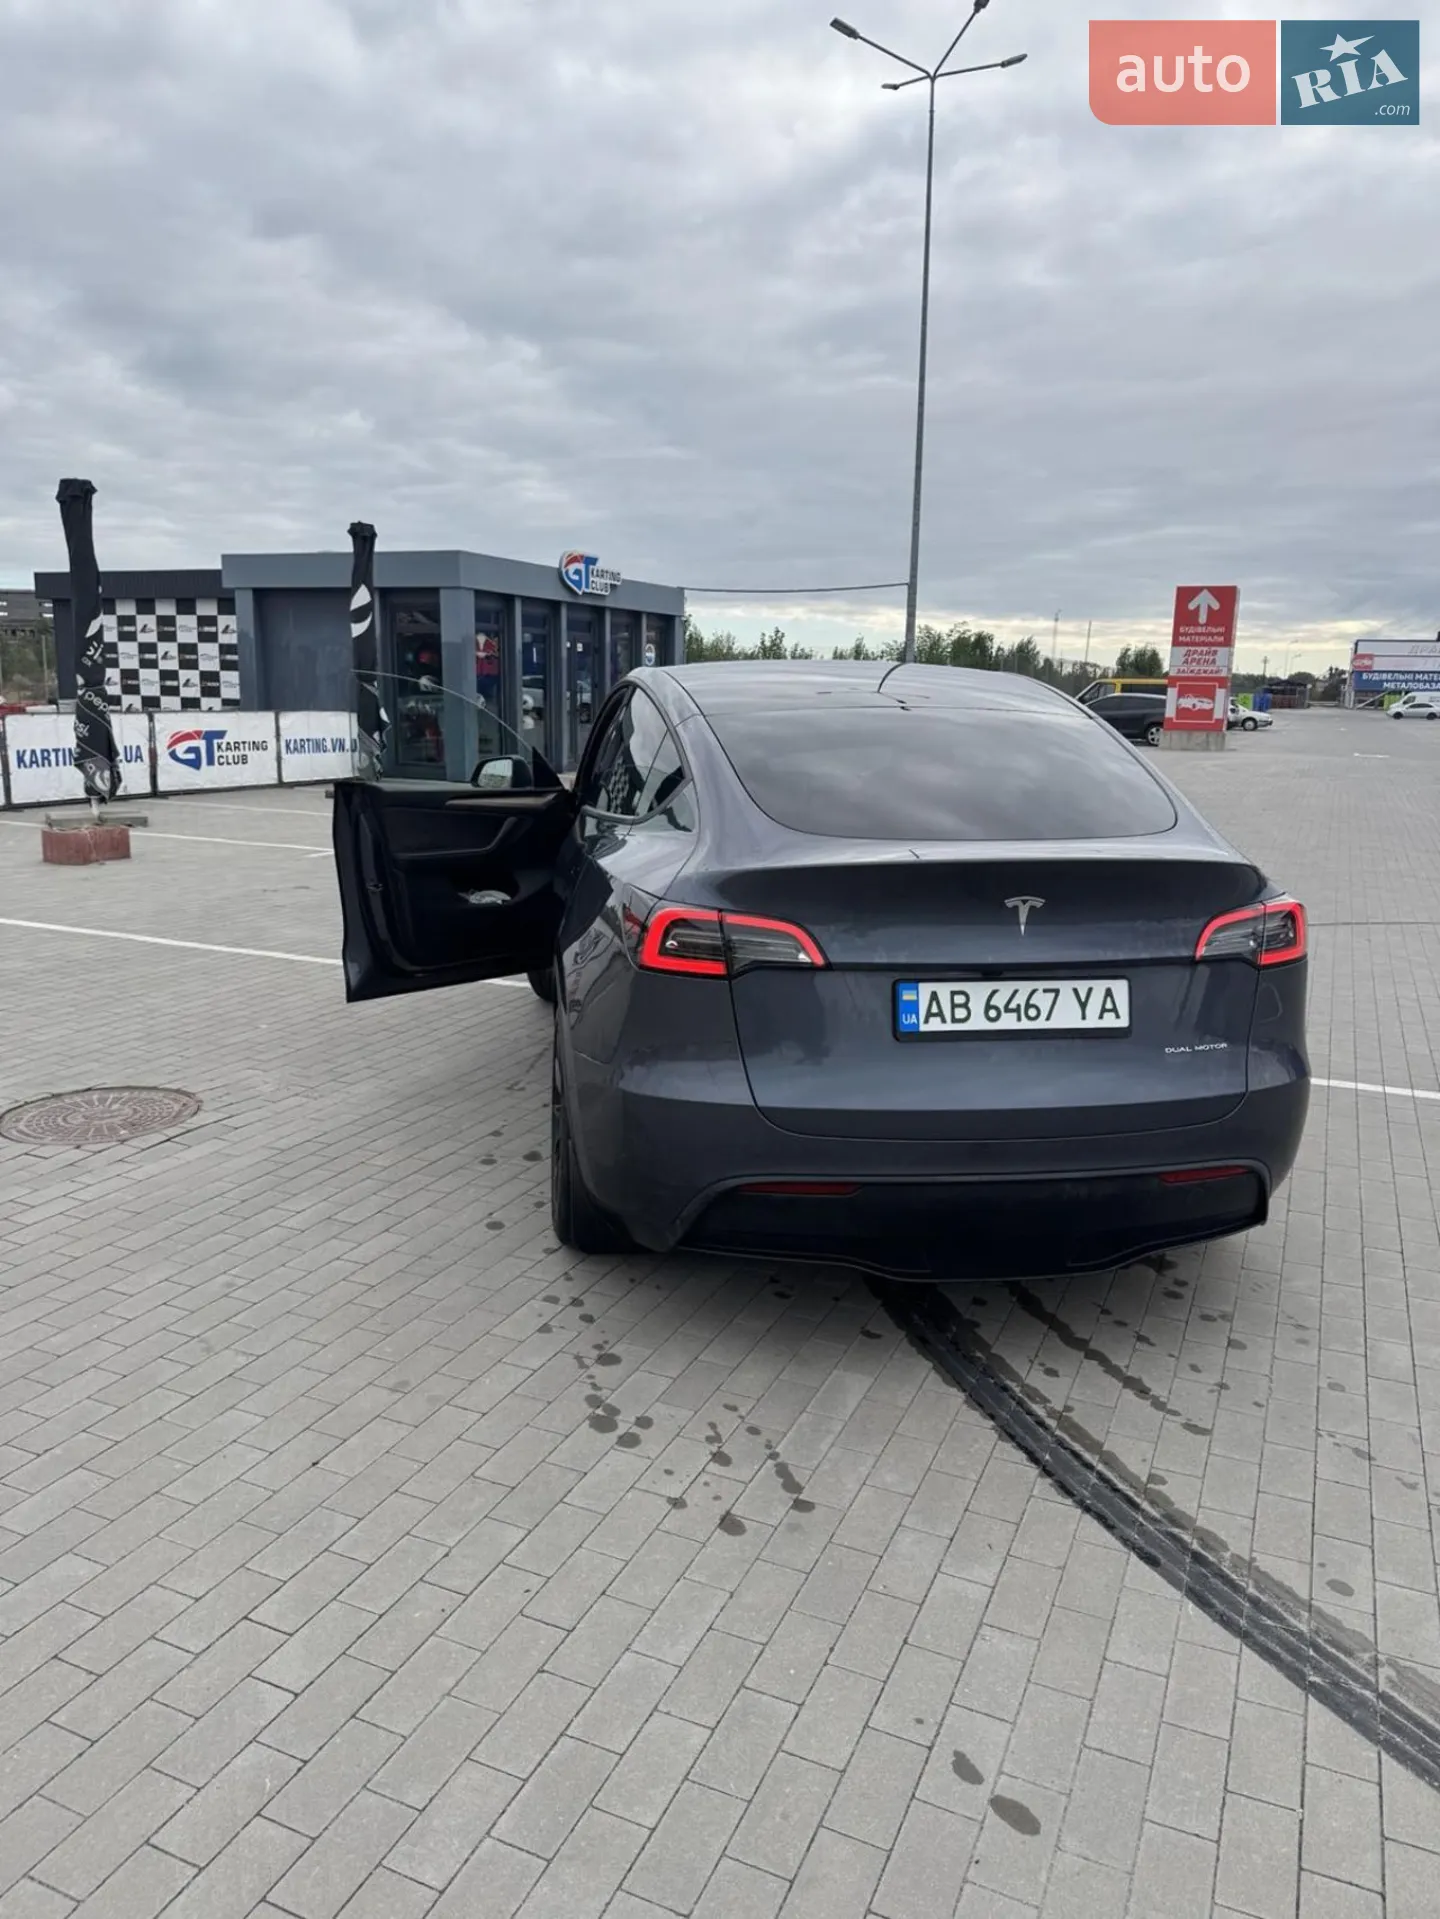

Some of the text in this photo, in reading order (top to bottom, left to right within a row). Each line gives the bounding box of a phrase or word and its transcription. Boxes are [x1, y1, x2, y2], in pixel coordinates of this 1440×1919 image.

[591, 567, 622, 584] KARTING
[591, 579, 610, 593] CLUB
[1178, 635, 1225, 643] МАТЕРІАЛИ
[1183, 647, 1218, 657] ДРАЙВ
[1182, 657, 1217, 666] АРЕНА
[1362, 673, 1440, 682] БУДІВЕЛЬНІ МАТЕ
[166, 729, 228, 771] GT
[216, 740, 269, 753] KARTING
[285, 738, 359, 755] KARTING.VN.U
[217, 754, 249, 766] CLUB
[923, 986, 1121, 1024] AB 6467 YA
[902, 1013, 918, 1025] UA
[1164, 1042, 1228, 1054] DUAL MOTOR
